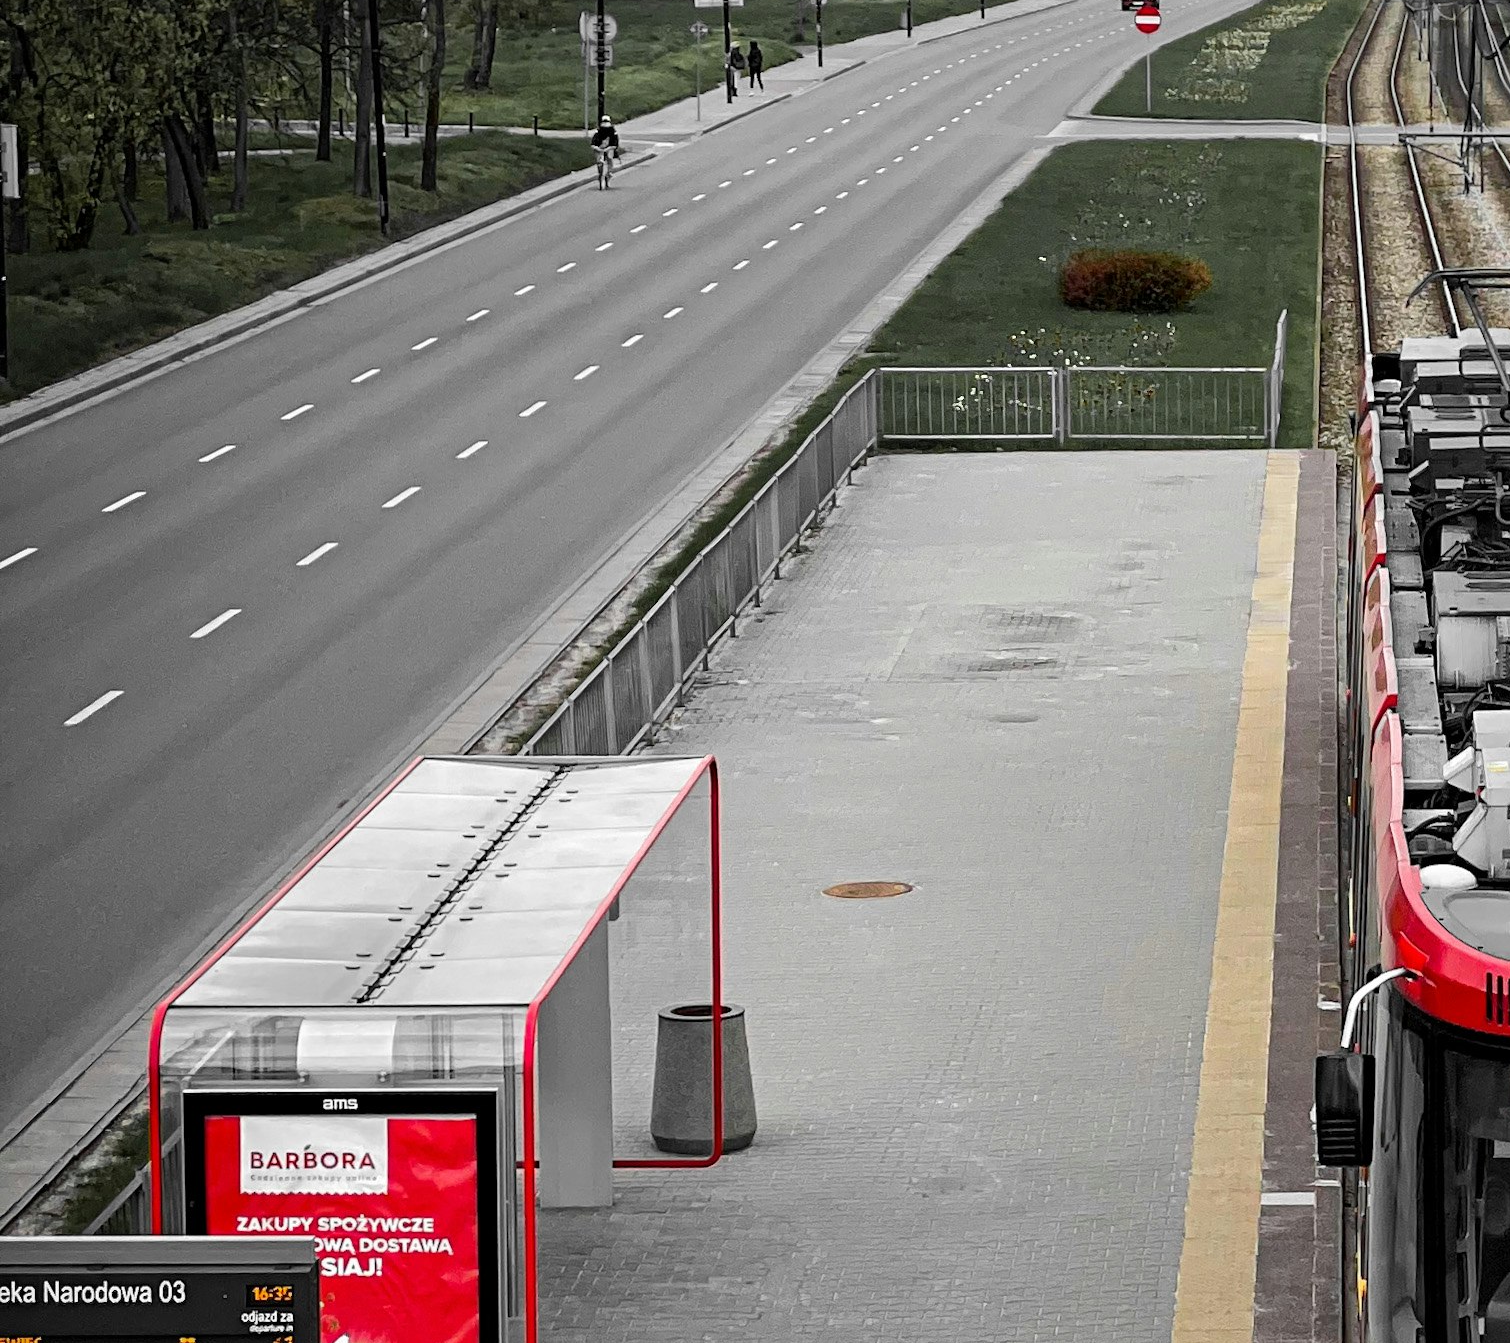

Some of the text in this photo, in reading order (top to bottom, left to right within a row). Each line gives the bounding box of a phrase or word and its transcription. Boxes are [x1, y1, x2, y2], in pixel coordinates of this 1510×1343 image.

[322, 1098, 358, 1110] ams
[250, 1150, 376, 1170] BARBORA
[236, 1214, 434, 1233] ZAKUPY SPOŻYWCZE
[359, 1237, 454, 1255] DOSTAWĄ
[320, 1257, 383, 1277] SIAJ!
[0, 1280, 186, 1303] eka Narodowa 03
[252, 1286, 292, 1301] 16:35
[241, 1310, 294, 1325] odjazd za
